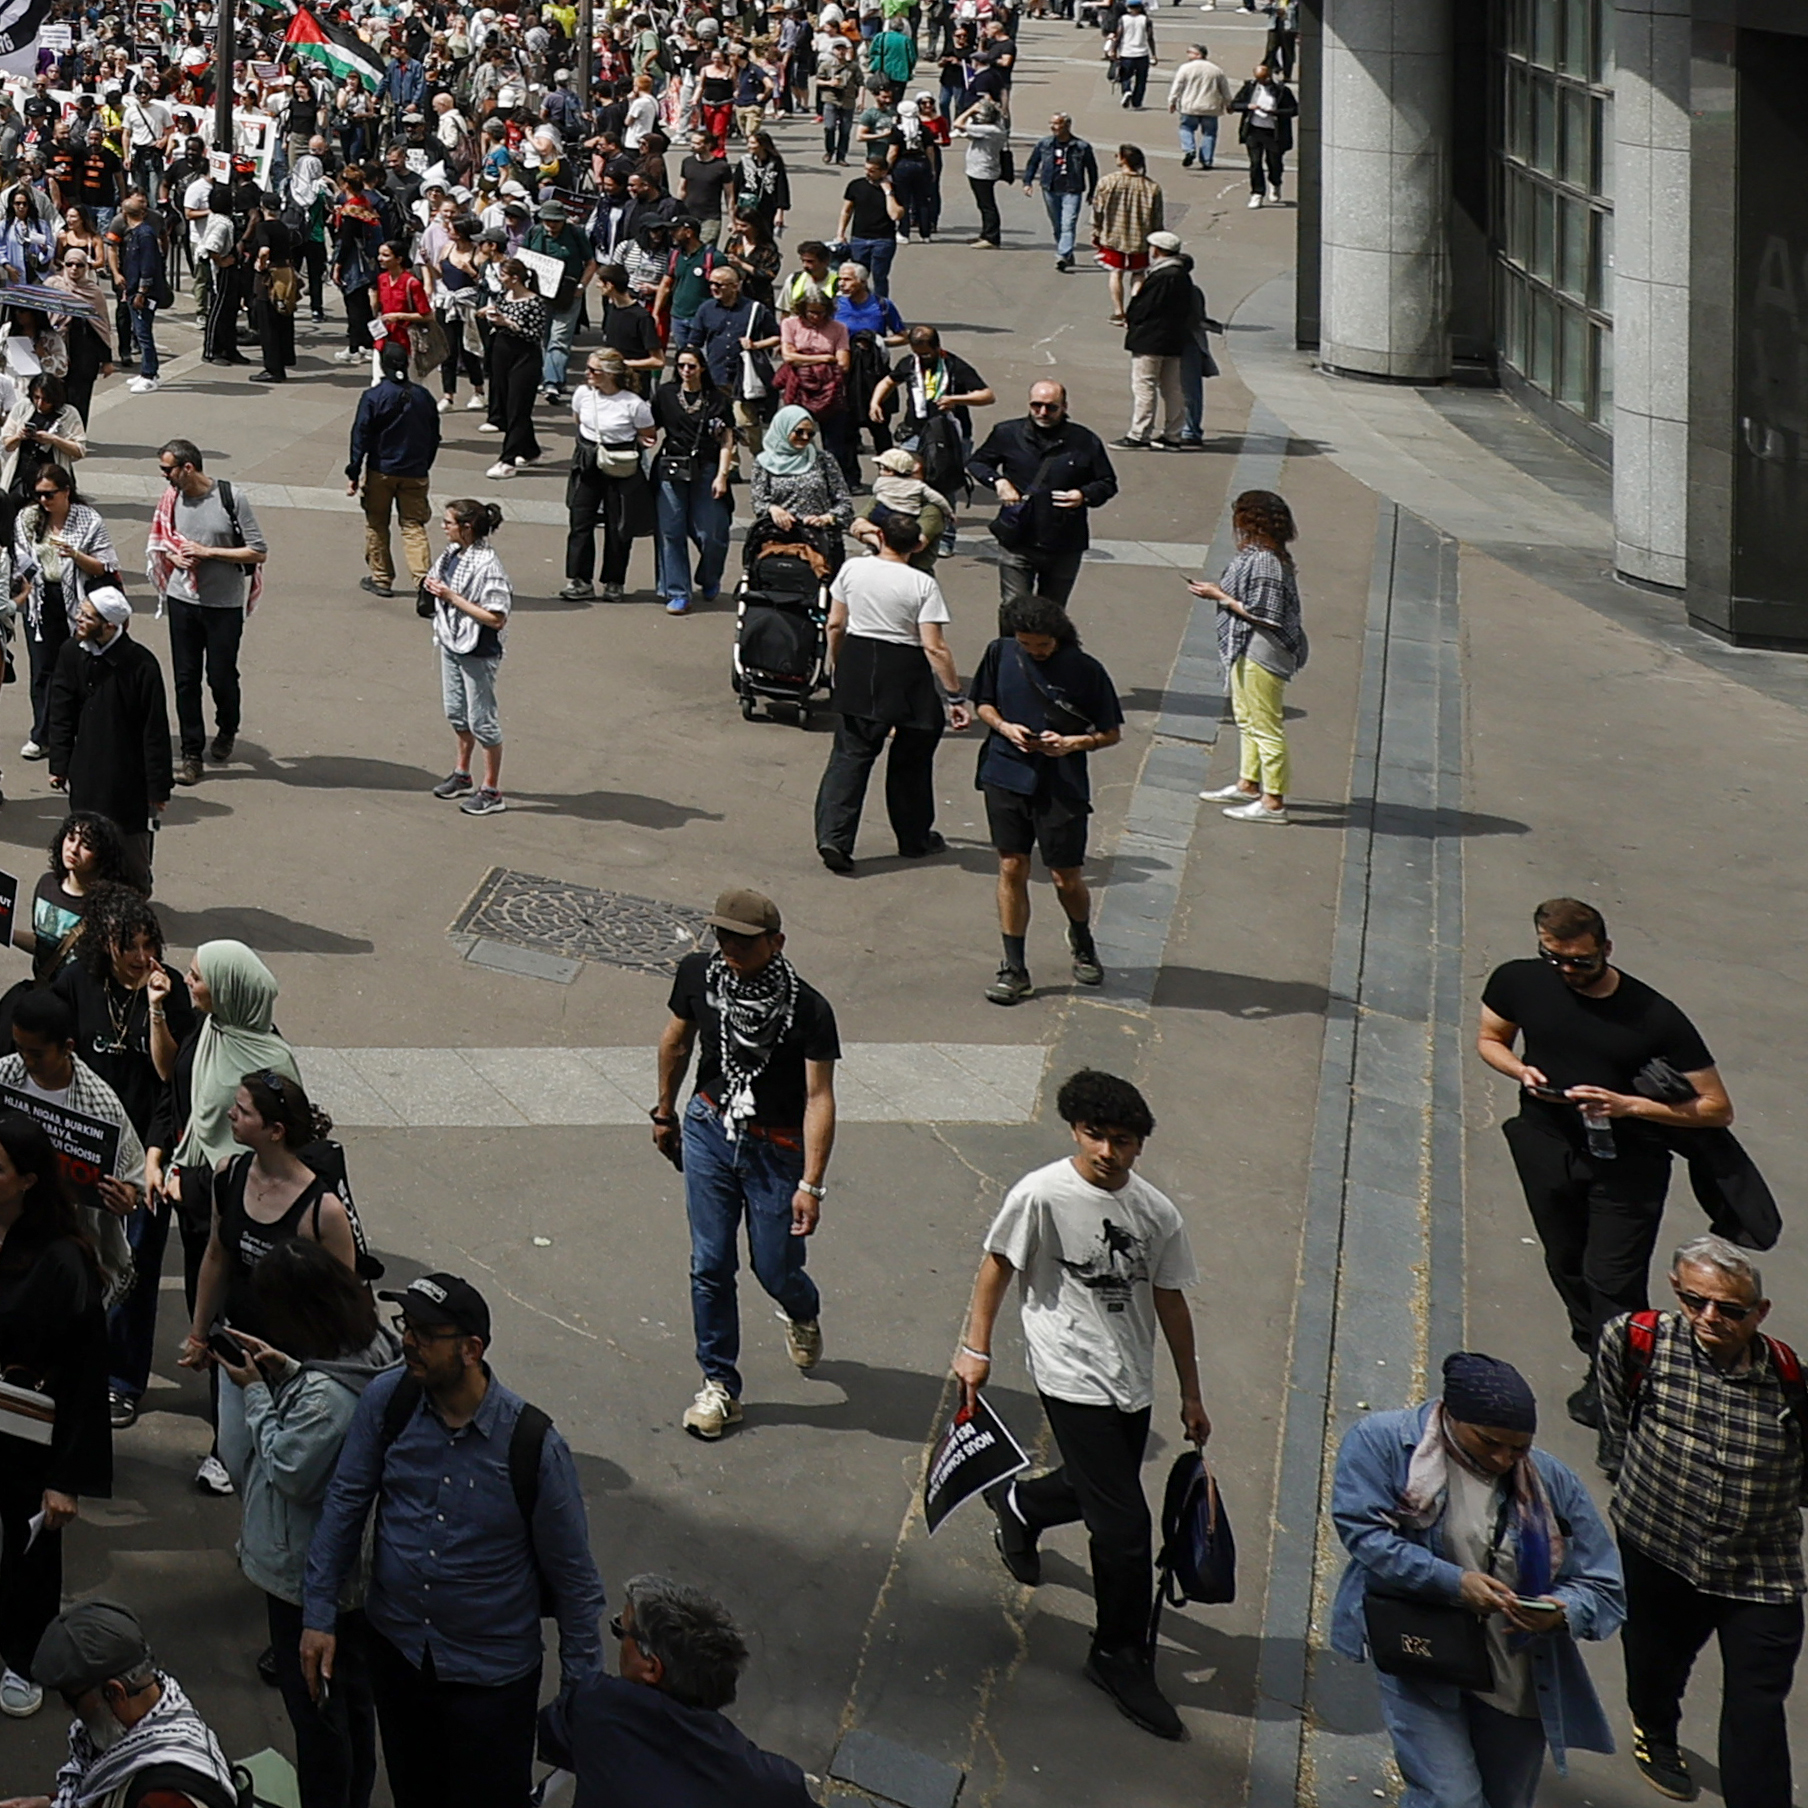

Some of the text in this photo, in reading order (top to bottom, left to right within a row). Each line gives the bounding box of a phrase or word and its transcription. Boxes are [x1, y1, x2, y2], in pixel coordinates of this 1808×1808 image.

[64, 1117, 105, 1141] BURKINI
[63, 1143, 102, 1166] CHOISIS
[963, 1430, 997, 1457] NOUS
